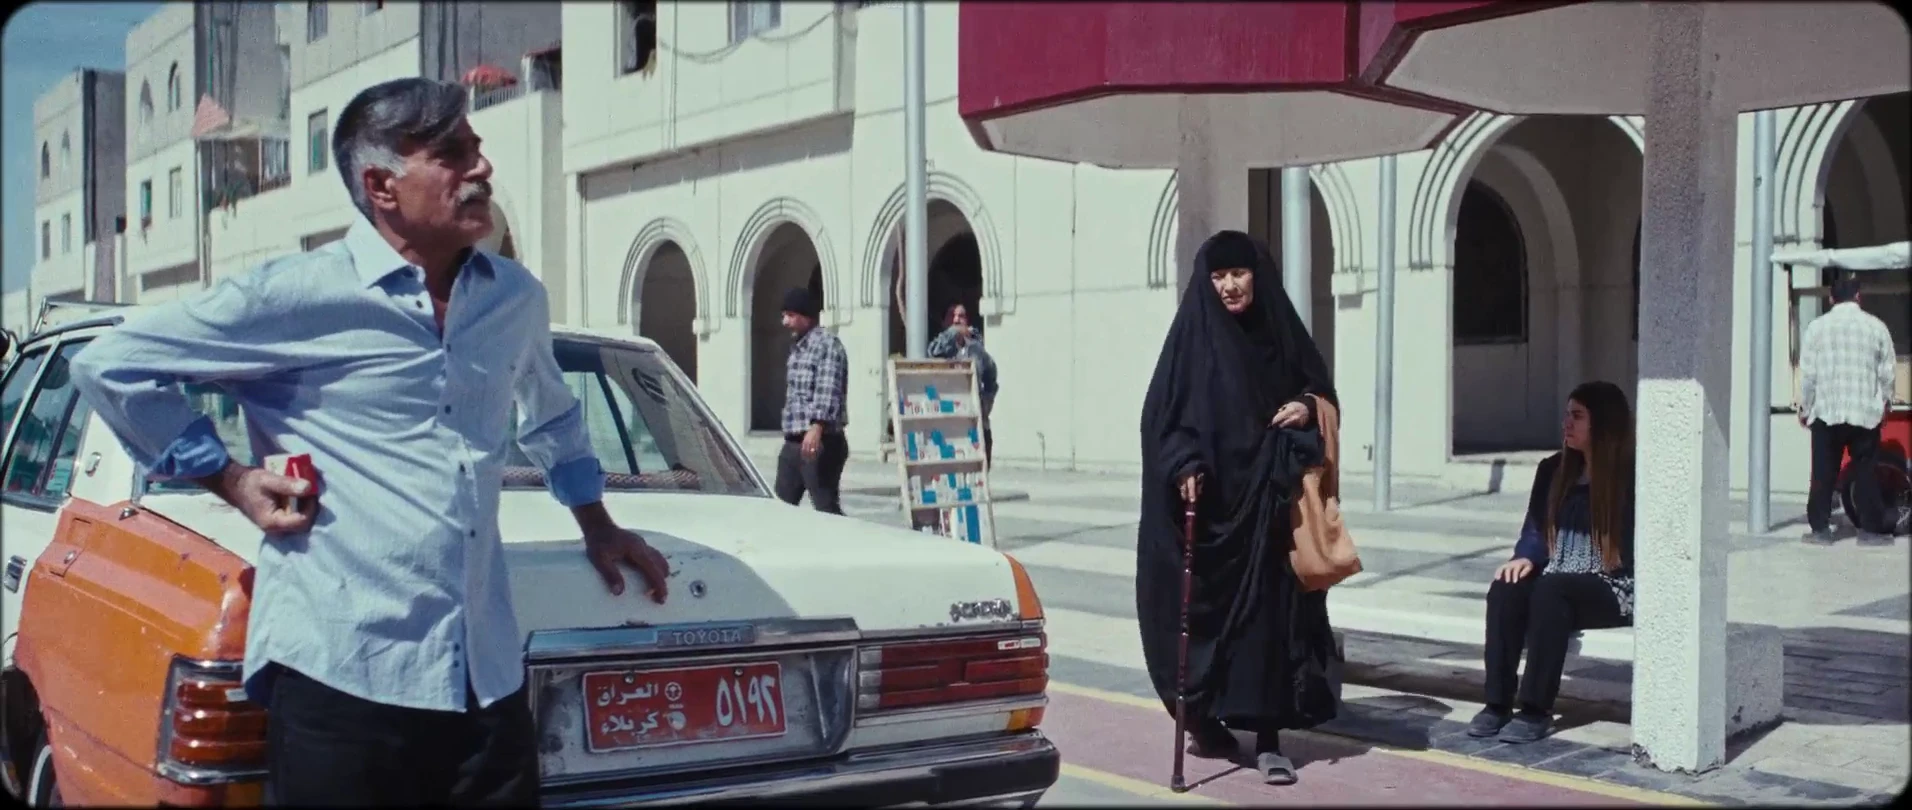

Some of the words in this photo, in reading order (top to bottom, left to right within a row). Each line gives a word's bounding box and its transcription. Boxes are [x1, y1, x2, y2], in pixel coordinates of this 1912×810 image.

[673, 629, 741, 645] TOYOTA
[597, 682, 659, 706] العراق
[601, 711, 658, 735] كربلاء
